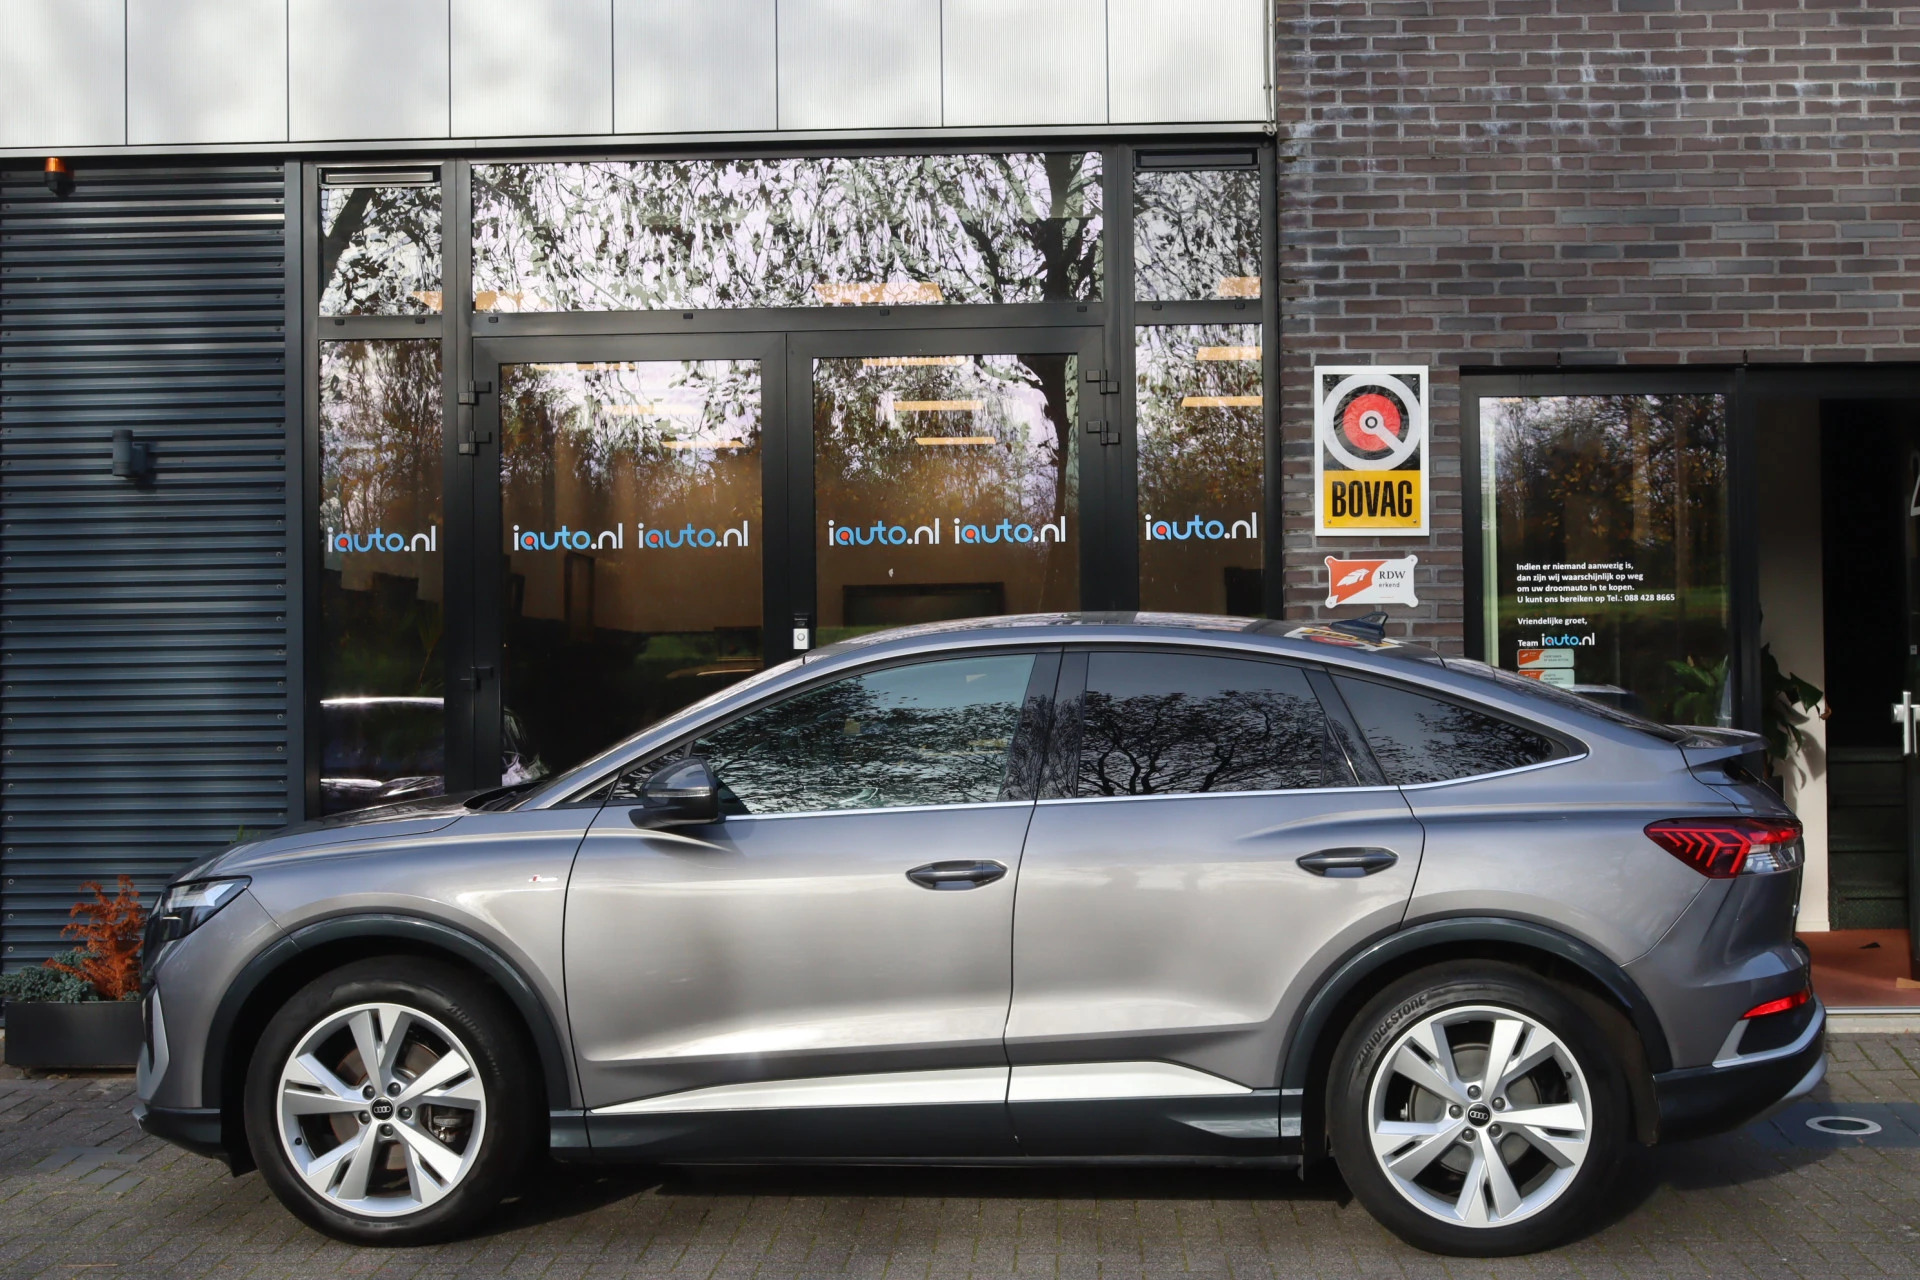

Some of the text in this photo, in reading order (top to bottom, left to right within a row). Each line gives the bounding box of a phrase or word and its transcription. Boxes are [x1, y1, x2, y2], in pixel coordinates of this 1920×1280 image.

[1332, 480, 1413, 517] BOVAG
[828, 515, 1066, 546] iauto.nl iauto.nl
[1145, 511, 1258, 541] iauto.nl
[328, 525, 436, 553] iauto.nl
[513, 520, 748, 551] iauto.nl iauto.nl
[1517, 562, 1541, 571] Indien
[1553, 561, 1587, 570] niemand
[1588, 561, 1624, 571] aanwezig
[1625, 561, 1634, 570] is,
[1378, 570, 1406, 580] RDW
[1517, 572, 1644, 583] dan zijn wij waarschijnlijk op weg
[1545, 584, 1589, 592] droomauto
[1590, 583, 1598, 592] in
[1599, 584, 1608, 592] te
[1609, 583, 1635, 593] kopen.
[1517, 595, 1524, 604] U
[1525, 595, 1543, 604] kunt
[1560, 594, 1594, 603] bereiken
[1595, 595, 1606, 604] op
[1607, 594, 1623, 602] Tel.:
[1624, 593, 1639, 602] 088
[1640, 593, 1655, 602] 428
[1656, 593, 1676, 602] 8665
[1517, 616, 1588, 626] Vriendelijke groet,
[1518, 633, 1595, 647] Team iauto.nl
